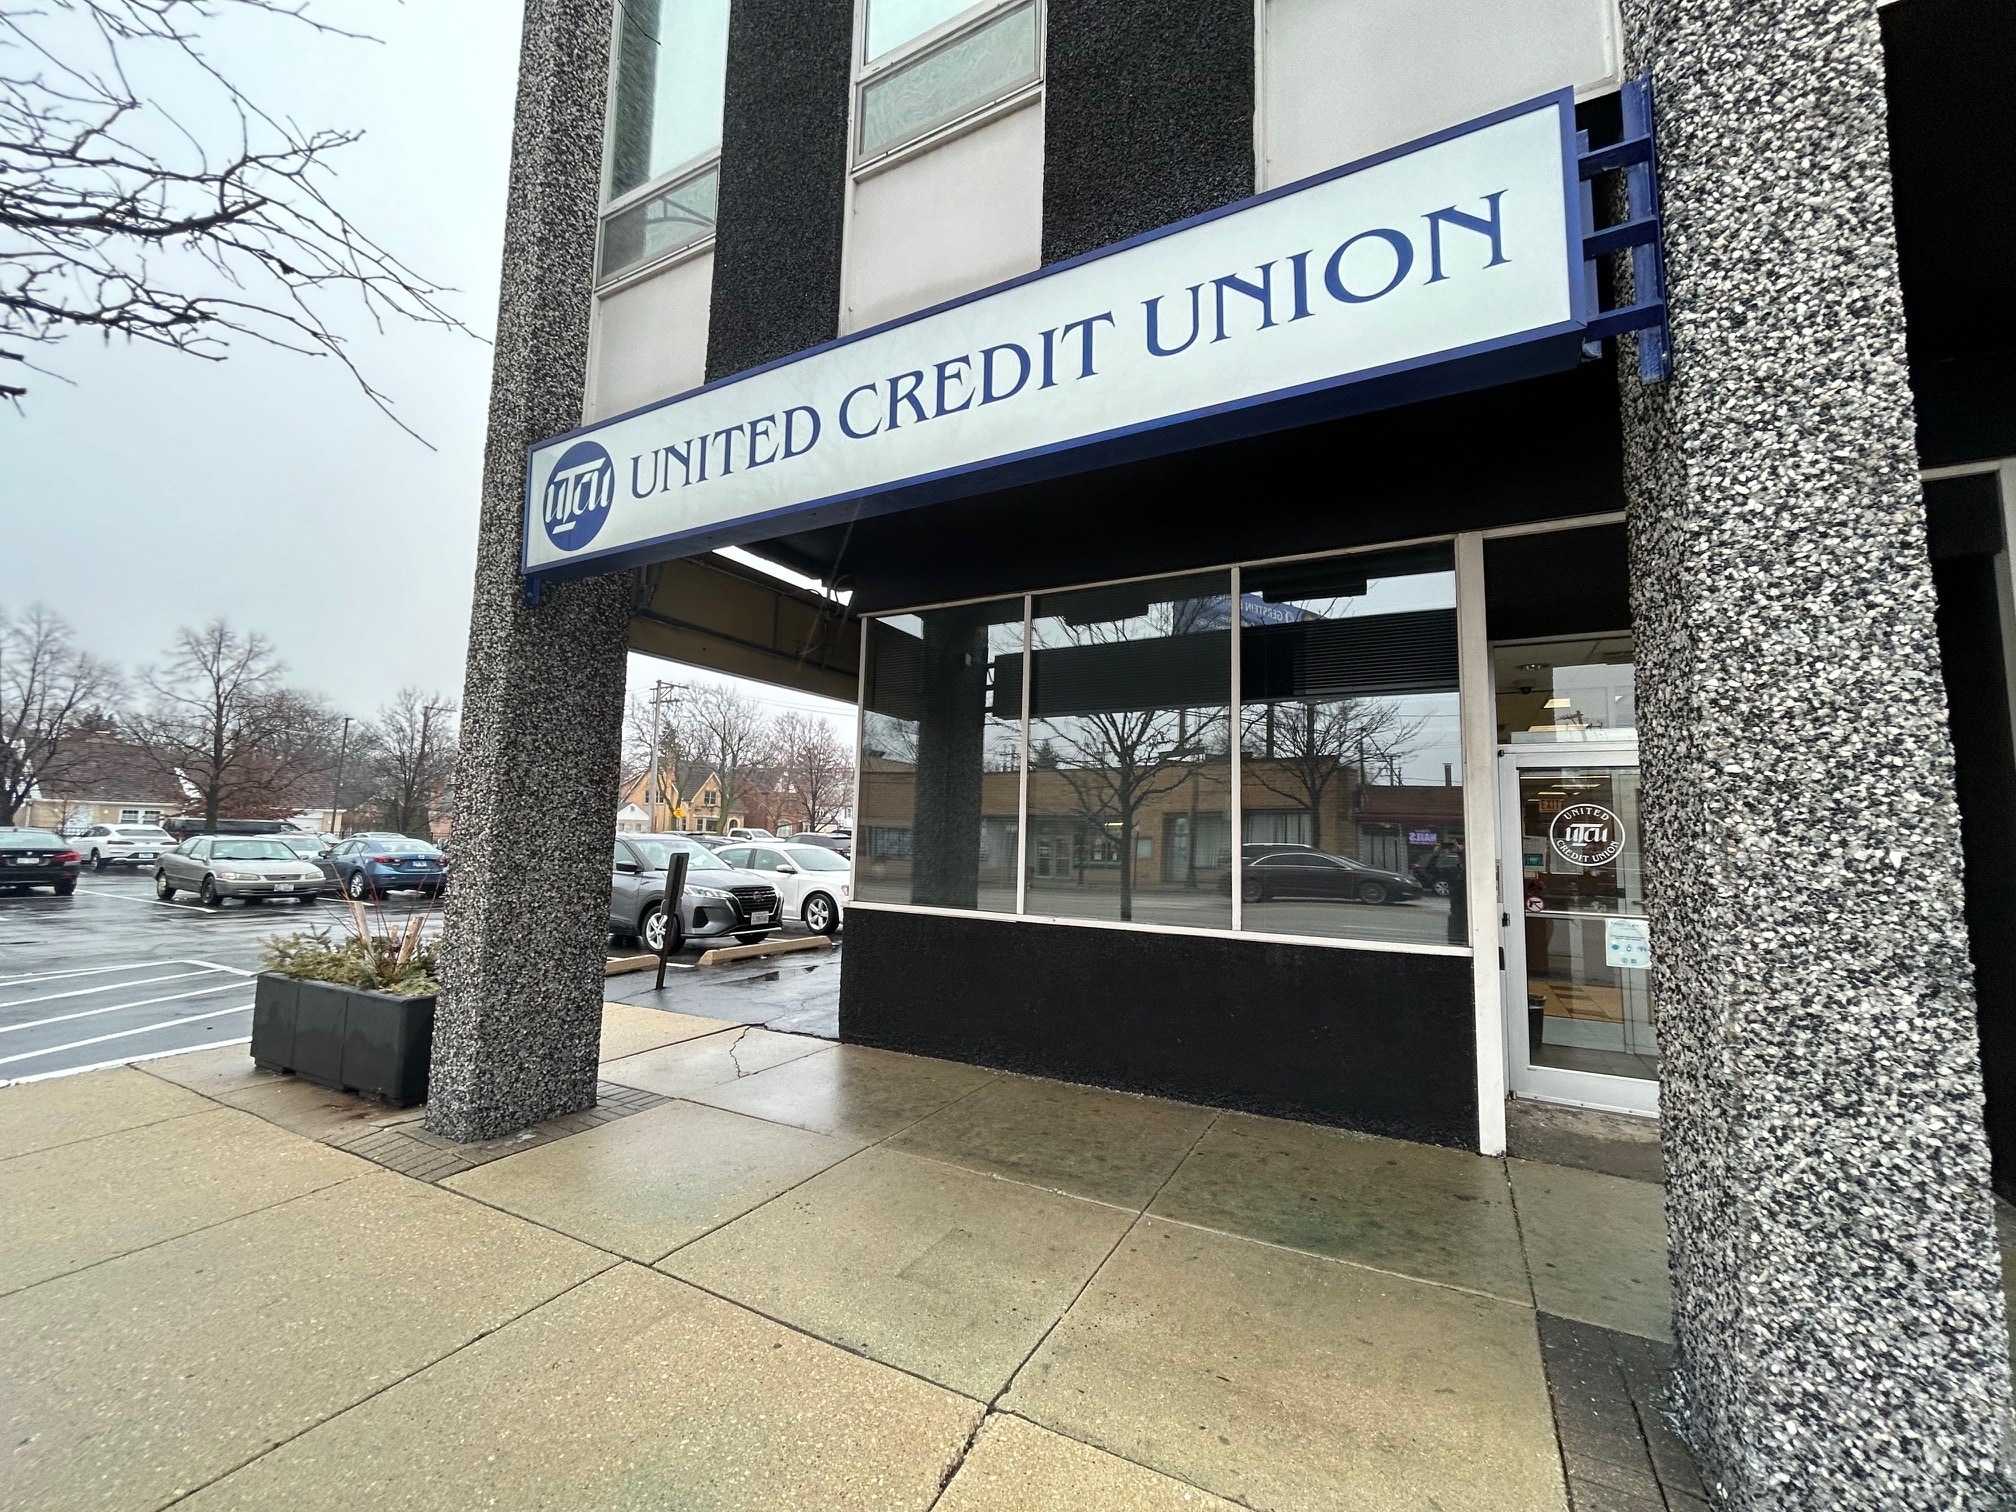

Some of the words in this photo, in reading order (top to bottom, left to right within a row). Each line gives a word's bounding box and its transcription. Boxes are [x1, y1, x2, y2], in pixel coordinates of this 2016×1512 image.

[631, 405, 821, 499] UNITED
[838, 311, 1114, 439] CREDIT
[1142, 189, 1511, 357] UNION
[1563, 807, 1610, 821] UNITED
[1556, 839, 1590, 863] CREDIT
[1591, 840, 1620, 862] UNION
